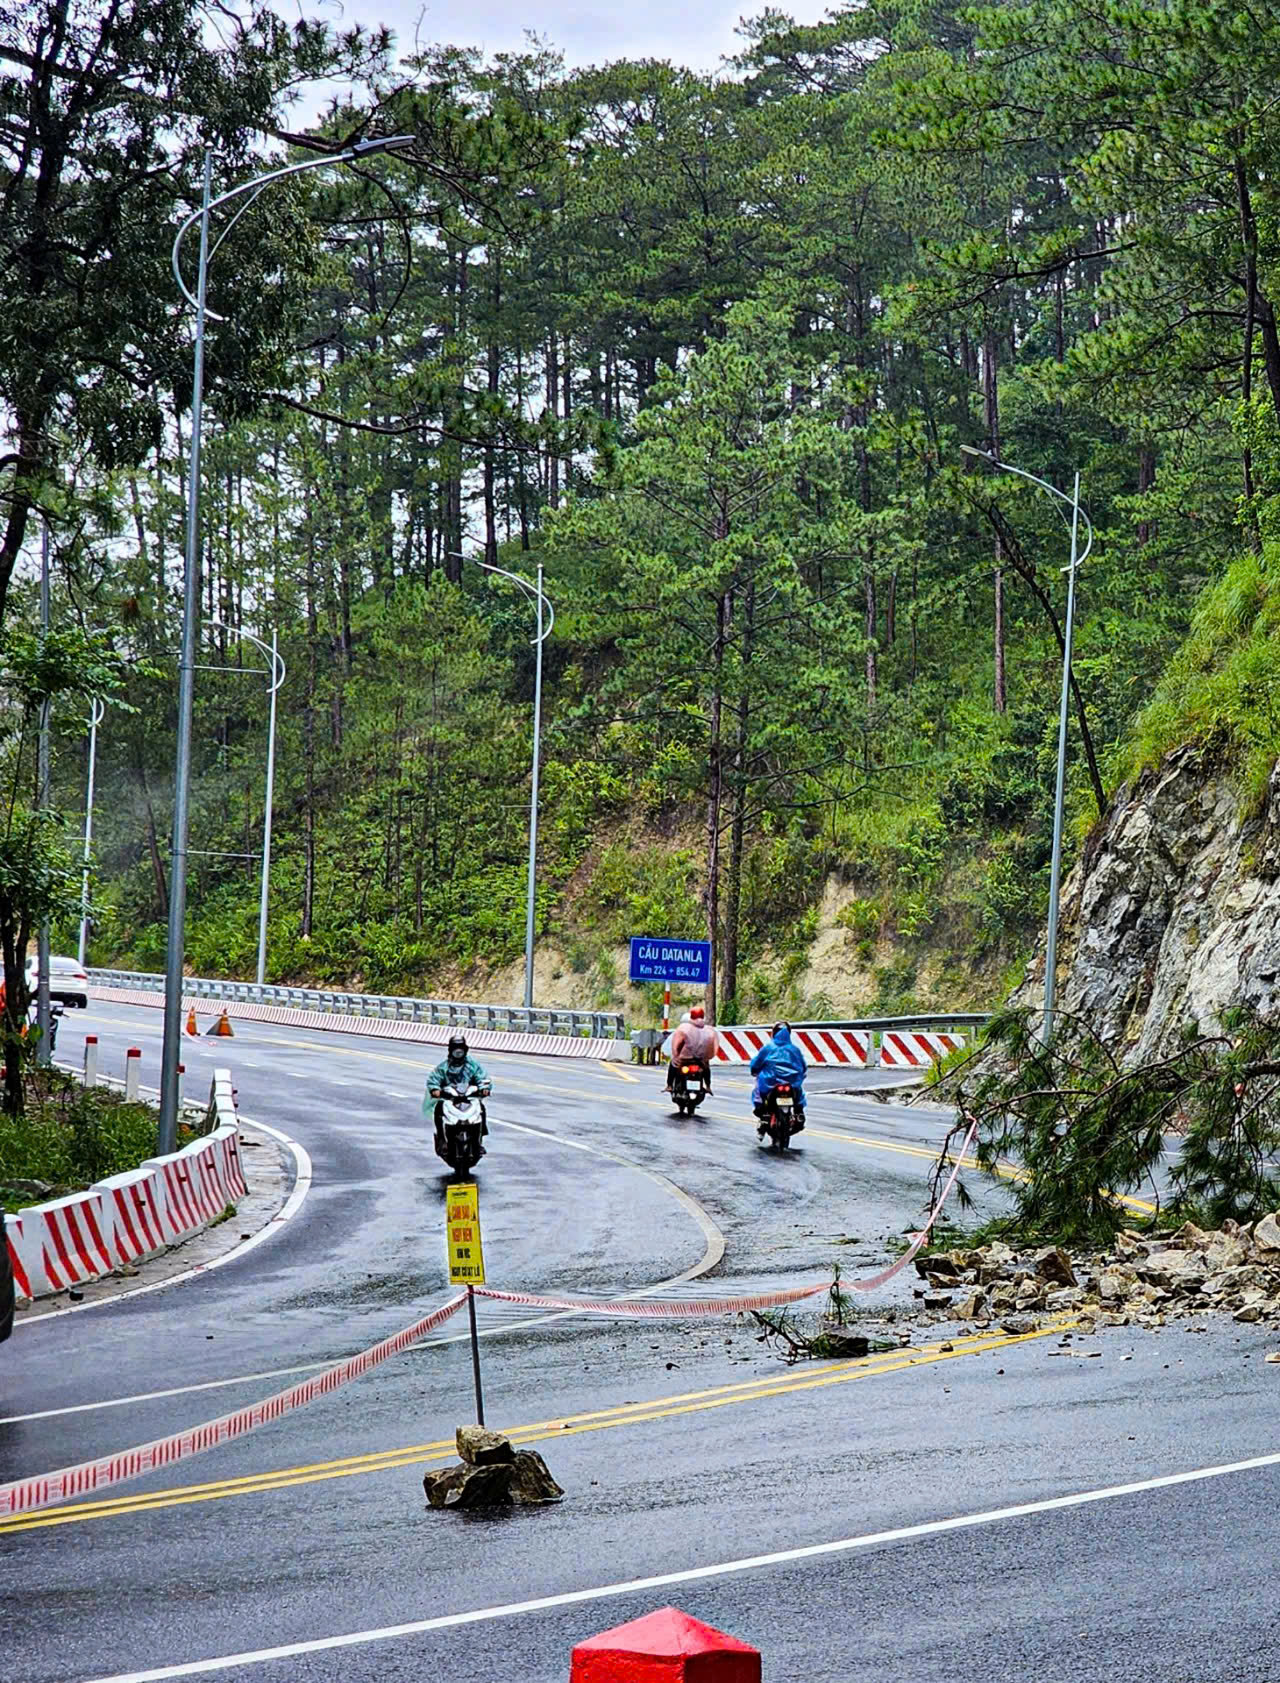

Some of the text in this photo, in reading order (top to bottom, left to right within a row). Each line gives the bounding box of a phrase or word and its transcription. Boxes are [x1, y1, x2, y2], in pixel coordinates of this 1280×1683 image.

[661, 948, 702, 962] DATANLA
[639, 964, 652, 975] Km
[653, 965, 667, 975] 224
